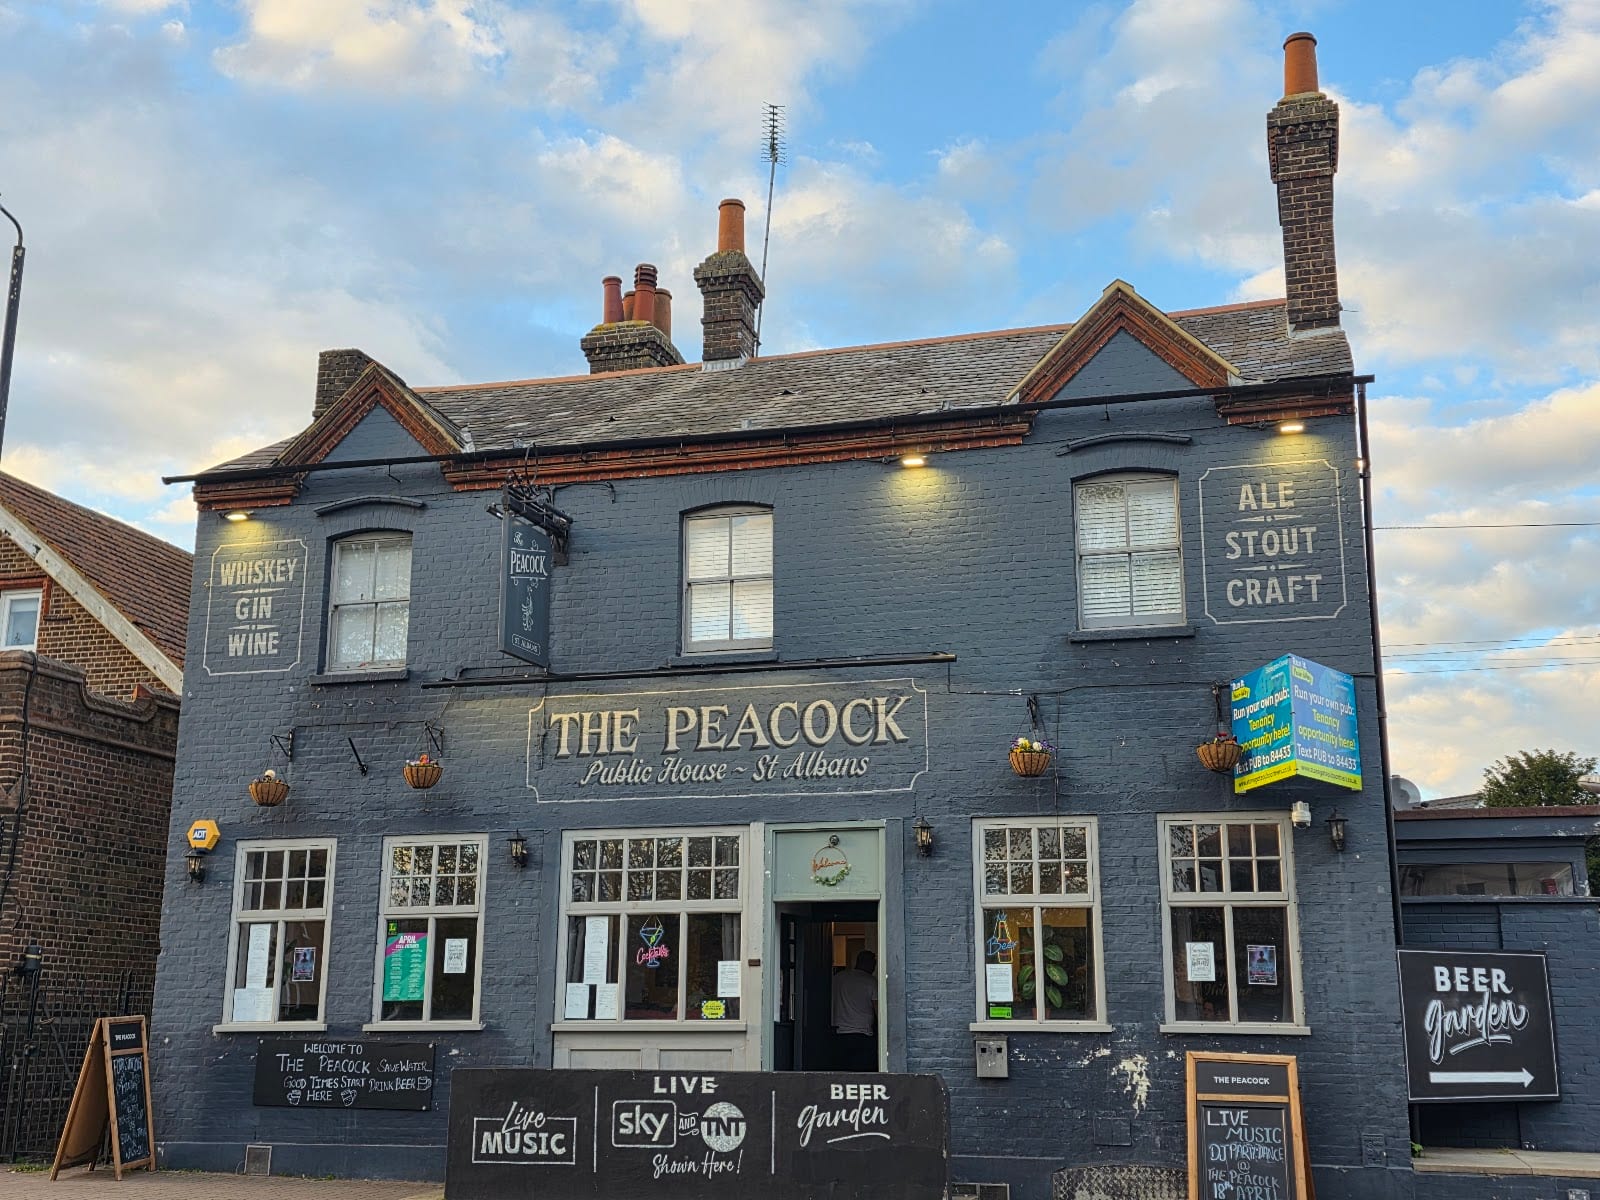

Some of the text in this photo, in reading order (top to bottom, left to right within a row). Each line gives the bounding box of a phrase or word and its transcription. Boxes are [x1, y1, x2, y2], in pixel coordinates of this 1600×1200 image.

[1238, 481, 1296, 511] ALE
[1225, 527, 1317, 560] STOUT
[220, 558, 298, 586] WHISKEY
[510, 550, 548, 576] PEACOCK
[1226, 574, 1322, 607] CRAFT
[235, 597, 272, 620] GIN
[228, 632, 279, 656] WINE
[1233, 687, 1290, 721] Run your own pub:
[1294, 684, 1308, 701] Run
[1308, 692, 1325, 706] your
[1325, 698, 1339, 710] own
[550, 695, 911, 757] THE PEACOCK
[1249, 713, 1275, 732] Tenancy
[1273, 723, 1290, 741] here!
[1312, 708, 1340, 732] Tenancy
[1298, 725, 1356, 751] opportunity here!
[580, 759, 652, 786] Public
[657, 757, 727, 783] House
[752, 755, 780, 781] St
[783, 751, 870, 778] Albans
[1235, 744, 1292, 775] Text PUB to 84433
[1297, 743, 1357, 771] Text PUB to 84433
[193, 830, 206, 839] ADT
[1434, 966, 1514, 994] BEER
[1424, 988, 1530, 1065] garden
[304, 1043, 363, 1055] WELCOME TO
[276, 1053, 370, 1074] THE PEACOCK
[377, 1059, 400, 1073] SAVE
[284, 1075, 367, 1090] GOOD TIMES START
[368, 1077, 416, 1093] DRINK BEER
[653, 1076, 719, 1094] LIVE
[830, 1084, 890, 1100] BEER
[1213, 1076, 1270, 1085] THE PEACOCK
[307, 1090, 333, 1102] HERE
[501, 1101, 546, 1133] Live
[619, 1104, 669, 1142] sky
[678, 1117, 696, 1130] AND
[702, 1117, 745, 1137] TNT
[797, 1099, 889, 1148] garden
[1207, 1110, 1249, 1126] LIVE
[480, 1131, 566, 1155] MUSIC
[1226, 1127, 1282, 1144] MUSIC
[1209, 1143, 1229, 1162] DJ
[652, 1154, 699, 1180] Shown
[1208, 1167, 1281, 1189] THE PEACOCK
